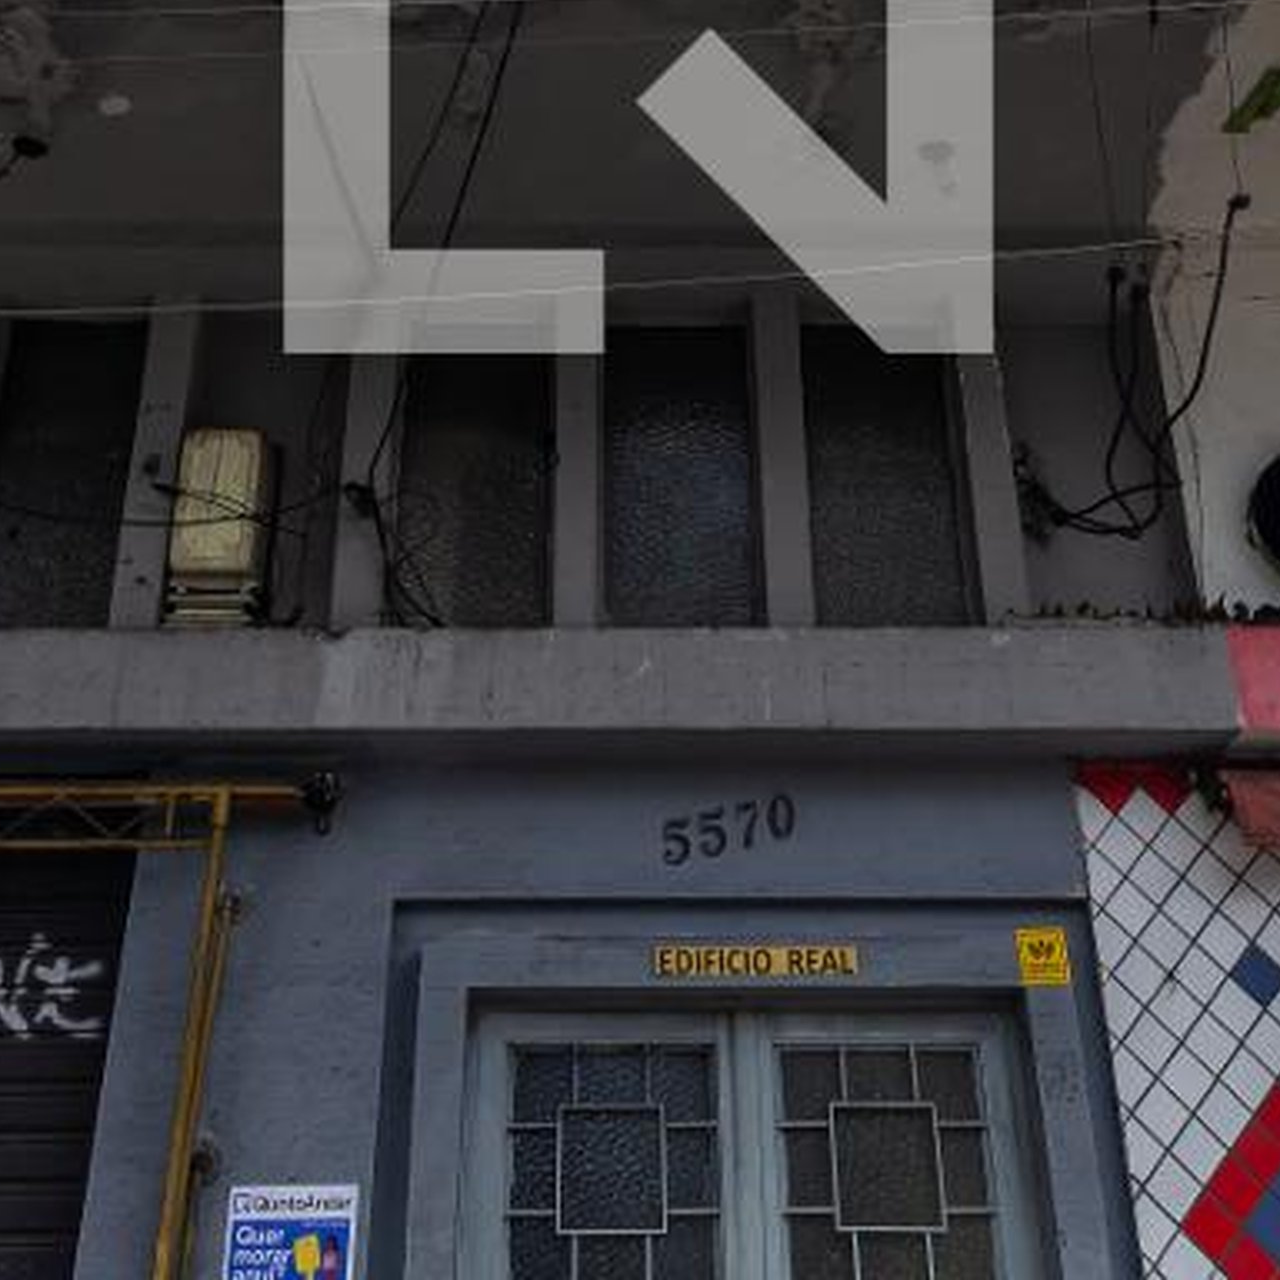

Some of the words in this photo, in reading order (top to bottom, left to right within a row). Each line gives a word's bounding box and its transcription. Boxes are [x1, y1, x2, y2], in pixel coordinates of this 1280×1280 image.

[662, 794, 795, 866] 5570
[658, 948, 771, 976] EDIFICIO
[786, 948, 854, 975] REAL
